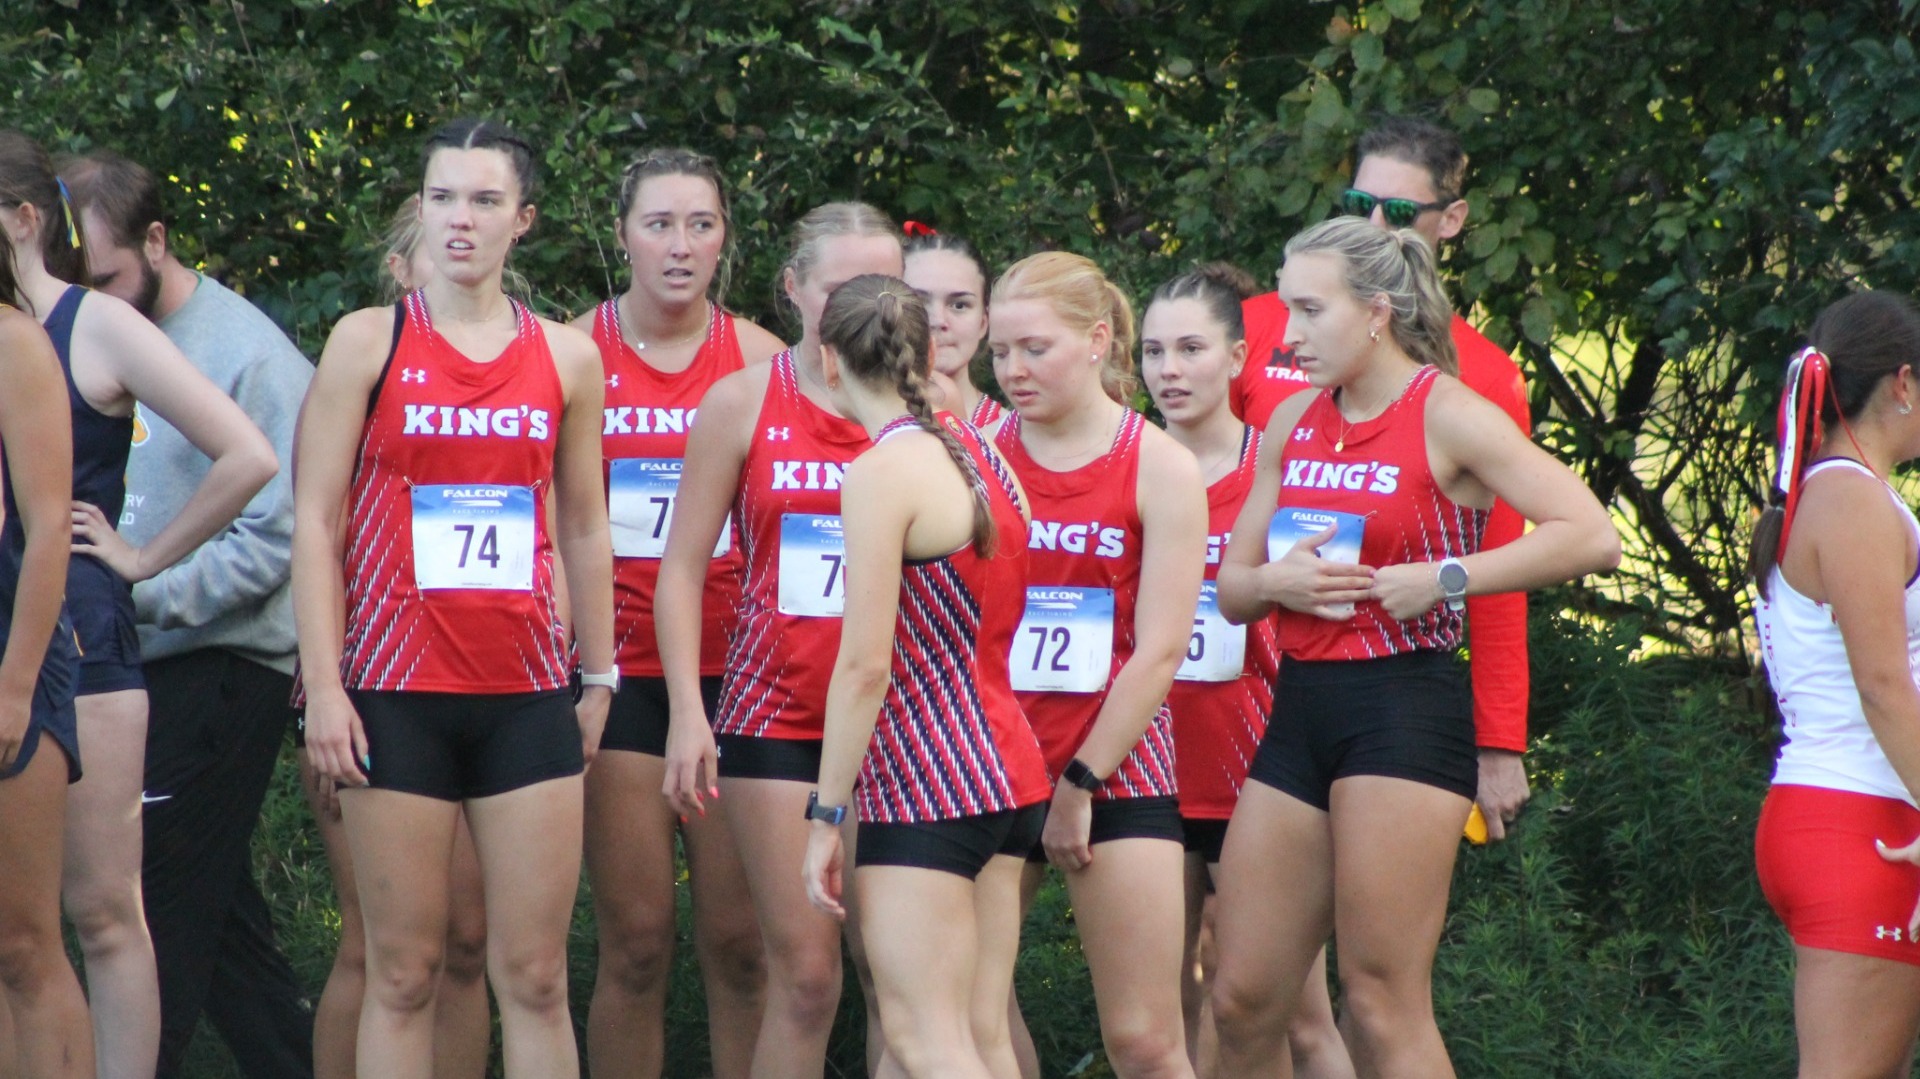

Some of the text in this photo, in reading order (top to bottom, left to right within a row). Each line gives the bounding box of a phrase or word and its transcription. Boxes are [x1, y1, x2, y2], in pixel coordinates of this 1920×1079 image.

[403, 404, 549, 440] KING'S
[443, 489, 508, 499] FALCON
[1282, 459, 1400, 495] KING'S
[650, 496, 676, 539] 7
[1292, 511, 1338, 524] FALCON
[454, 524, 501, 569] 74
[821, 554, 844, 598] 7
[1028, 626, 1071, 672] 72
